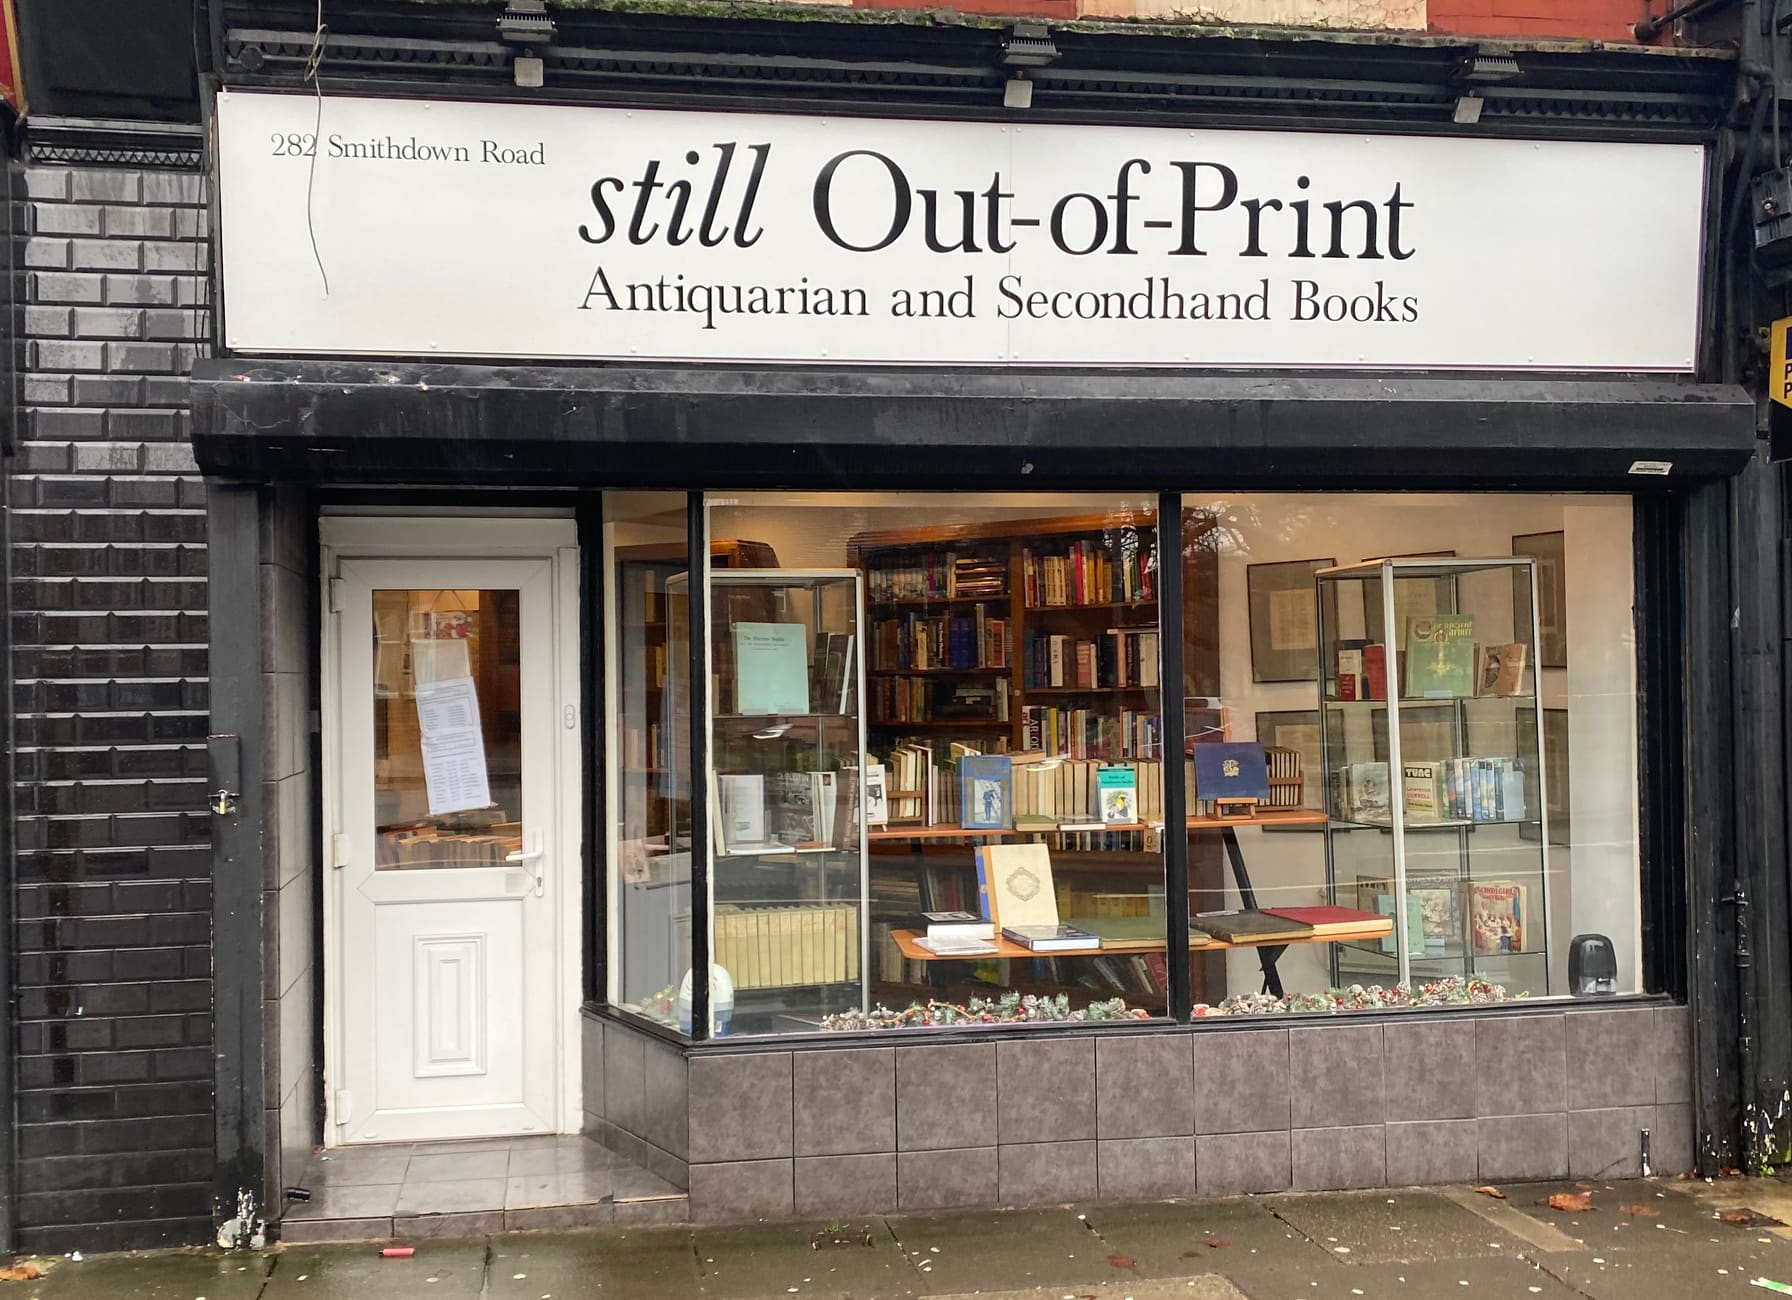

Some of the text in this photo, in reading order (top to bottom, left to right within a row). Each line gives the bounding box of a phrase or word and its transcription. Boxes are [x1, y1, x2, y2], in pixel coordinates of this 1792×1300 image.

[270, 133, 545, 165] 282 Smithdown Road
[578, 141, 1416, 261] still Out-of-Print
[577, 266, 1419, 330] Antiquarian and Secondhand Books
